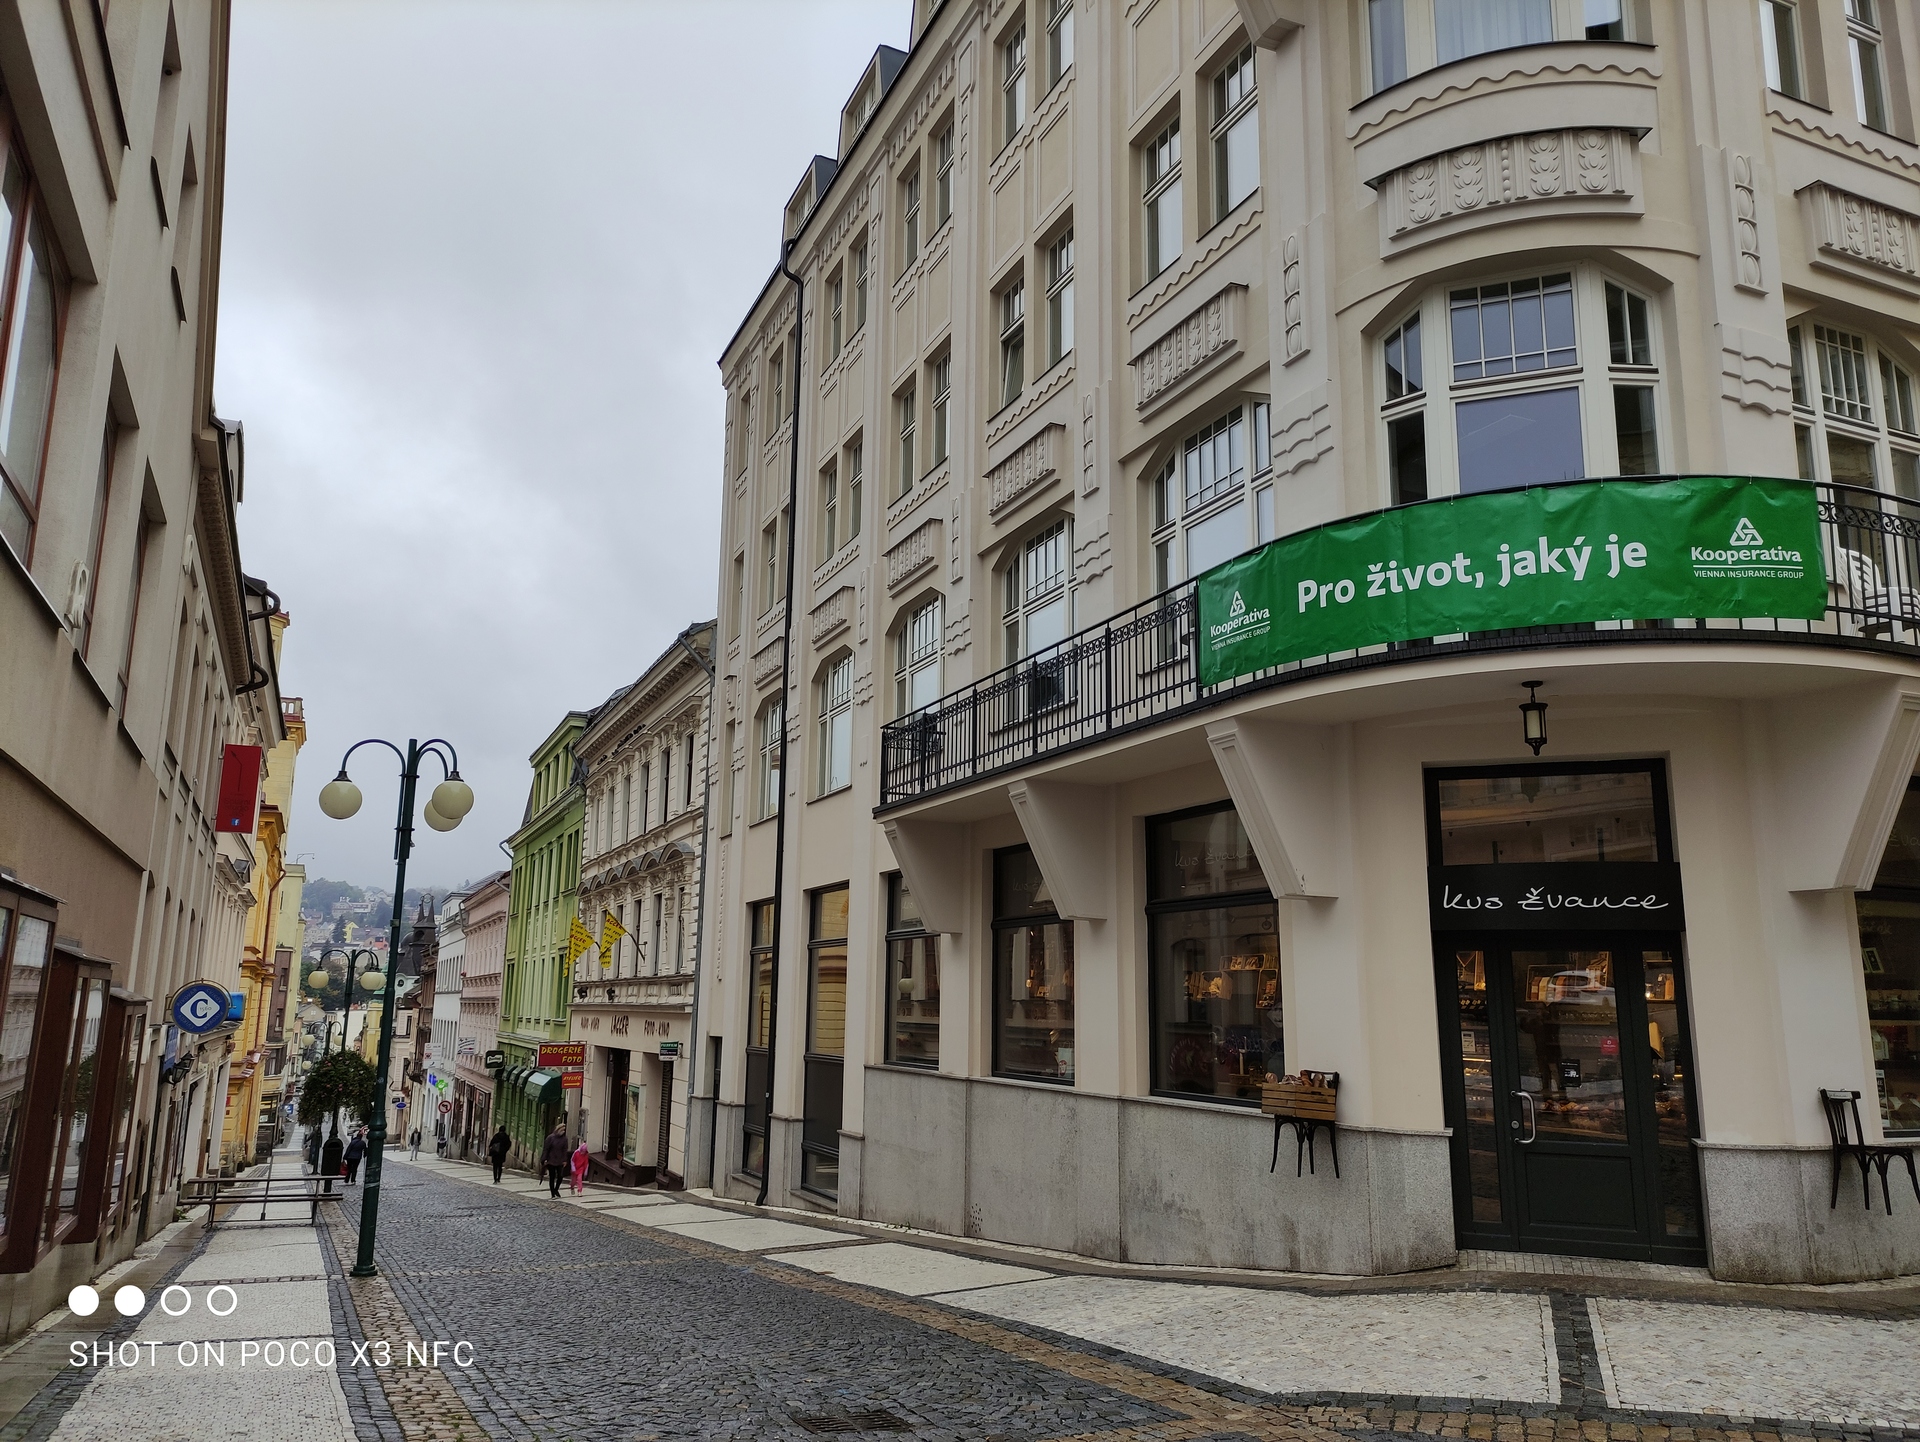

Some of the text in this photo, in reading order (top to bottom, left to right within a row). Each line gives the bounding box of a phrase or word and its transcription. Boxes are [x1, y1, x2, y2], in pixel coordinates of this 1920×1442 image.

[1691, 546, 1803, 565] Kooperativa
[1298, 533, 1647, 614] Pro život, jaký je
[1694, 570, 1804, 579] VIENNA INSURANCE GROUP
[1210, 608, 1270, 639] Kooperativa
[1211, 626, 1271, 652] VIENNA INSURANCE GROUP
[190, 998, 209, 1019] C
[541, 1046, 583, 1055] DROGERIE
[561, 1055, 582, 1064] FOTO
